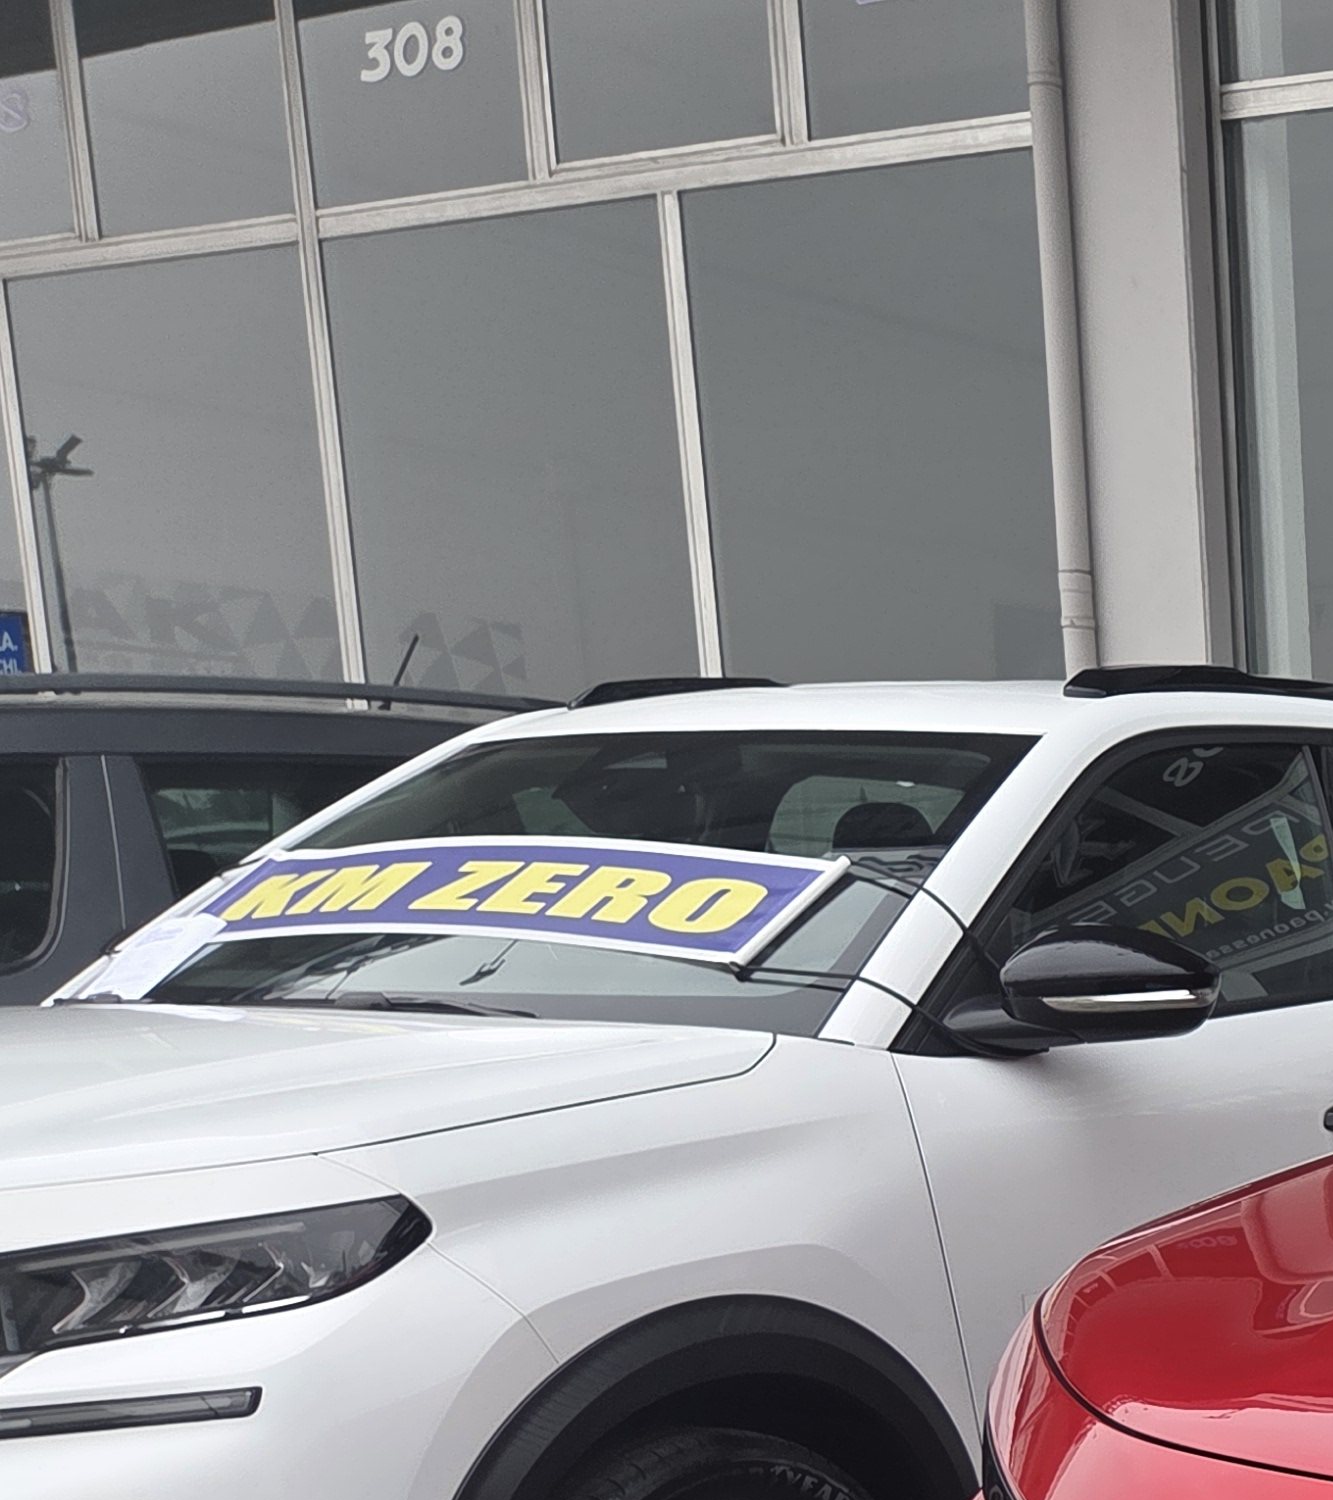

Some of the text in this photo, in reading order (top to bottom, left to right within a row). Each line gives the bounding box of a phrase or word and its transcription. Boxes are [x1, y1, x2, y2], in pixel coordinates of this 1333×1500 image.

[360, 15, 463, 82] 308
[224, 861, 769, 934] KM ZERO
